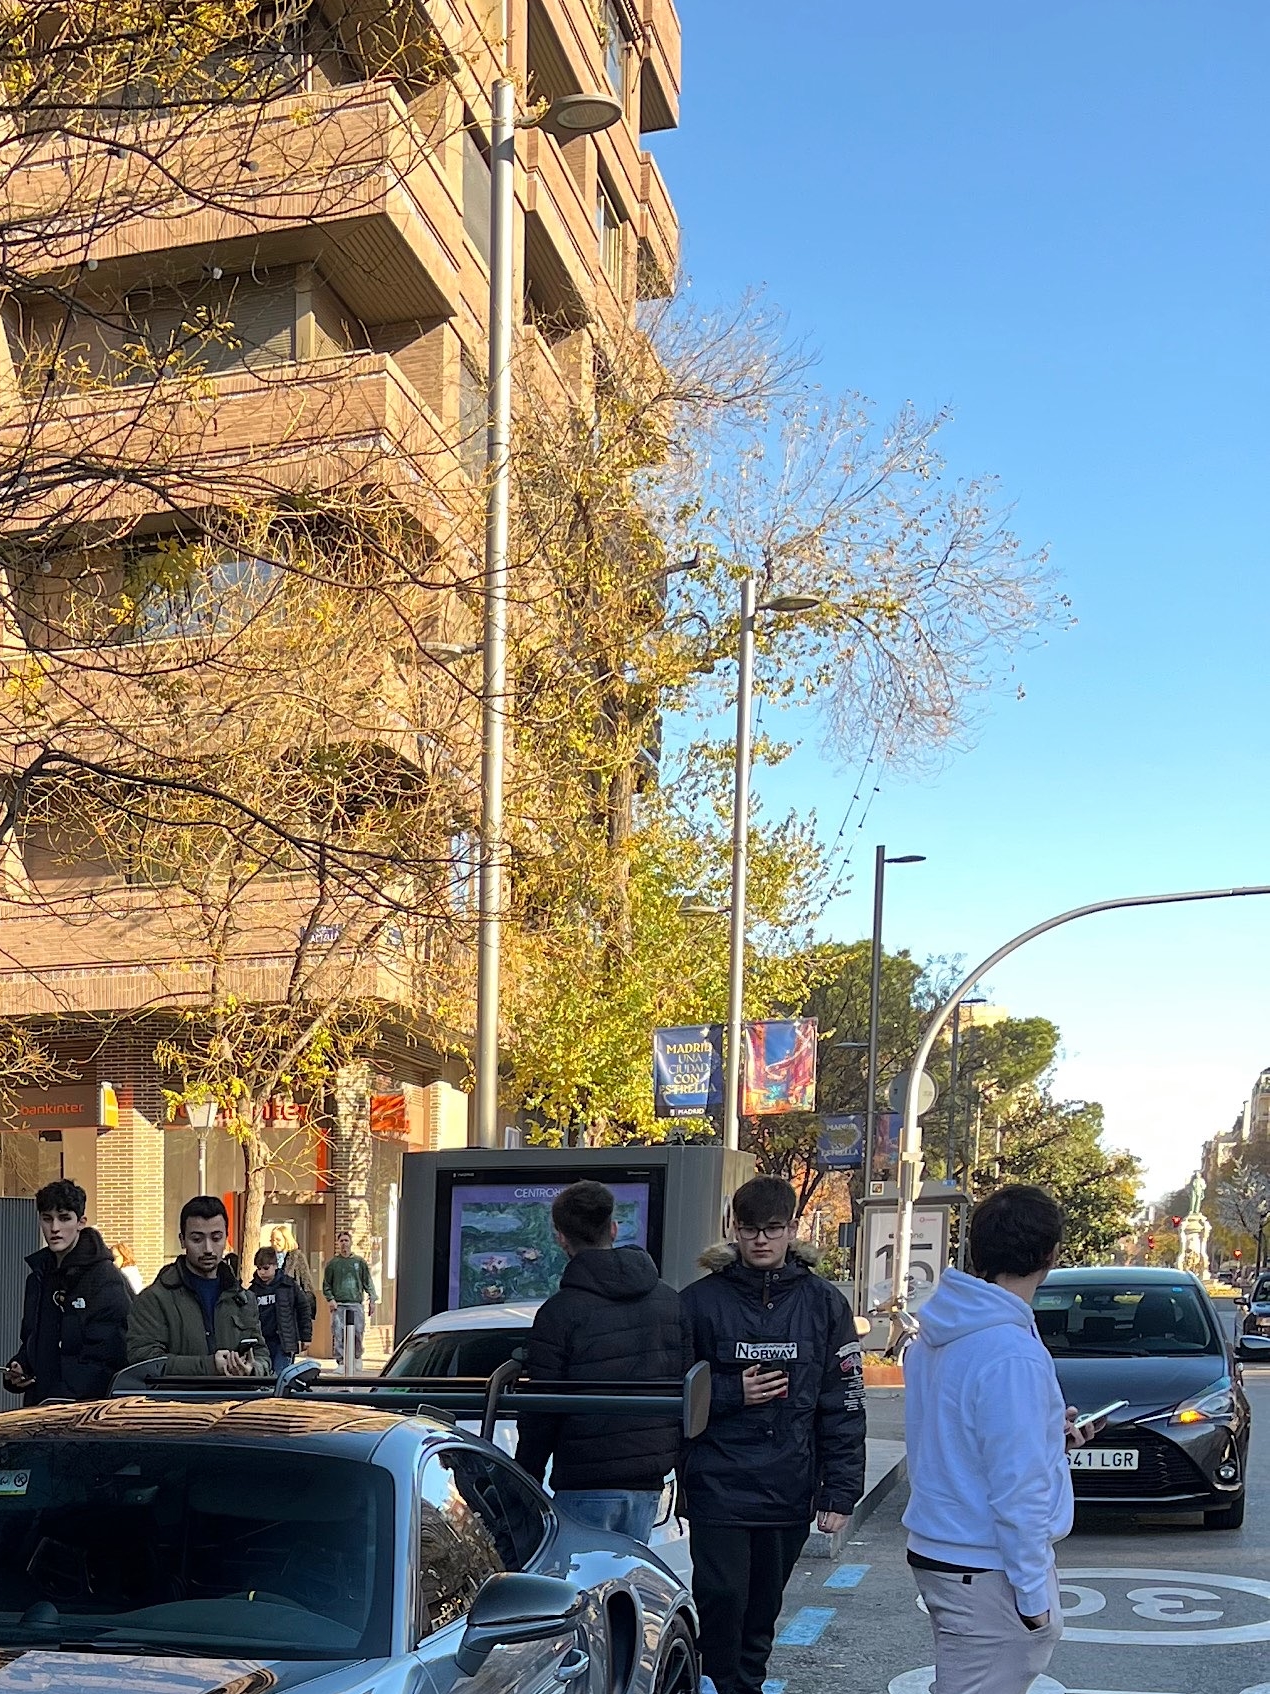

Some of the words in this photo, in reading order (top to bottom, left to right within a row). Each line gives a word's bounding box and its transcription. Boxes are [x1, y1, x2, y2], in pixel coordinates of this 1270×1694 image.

[666, 1042, 713, 1055] MADRID
[678, 1053, 702, 1064] UNA
[668, 1063, 711, 1075] CIUDAD
[673, 1074, 700, 1085] CON
[659, 1083, 717, 1096] ESTRELLA
[678, 1108, 705, 1116] MADRID
[1101, 1452, 1134, 1467] LGR
